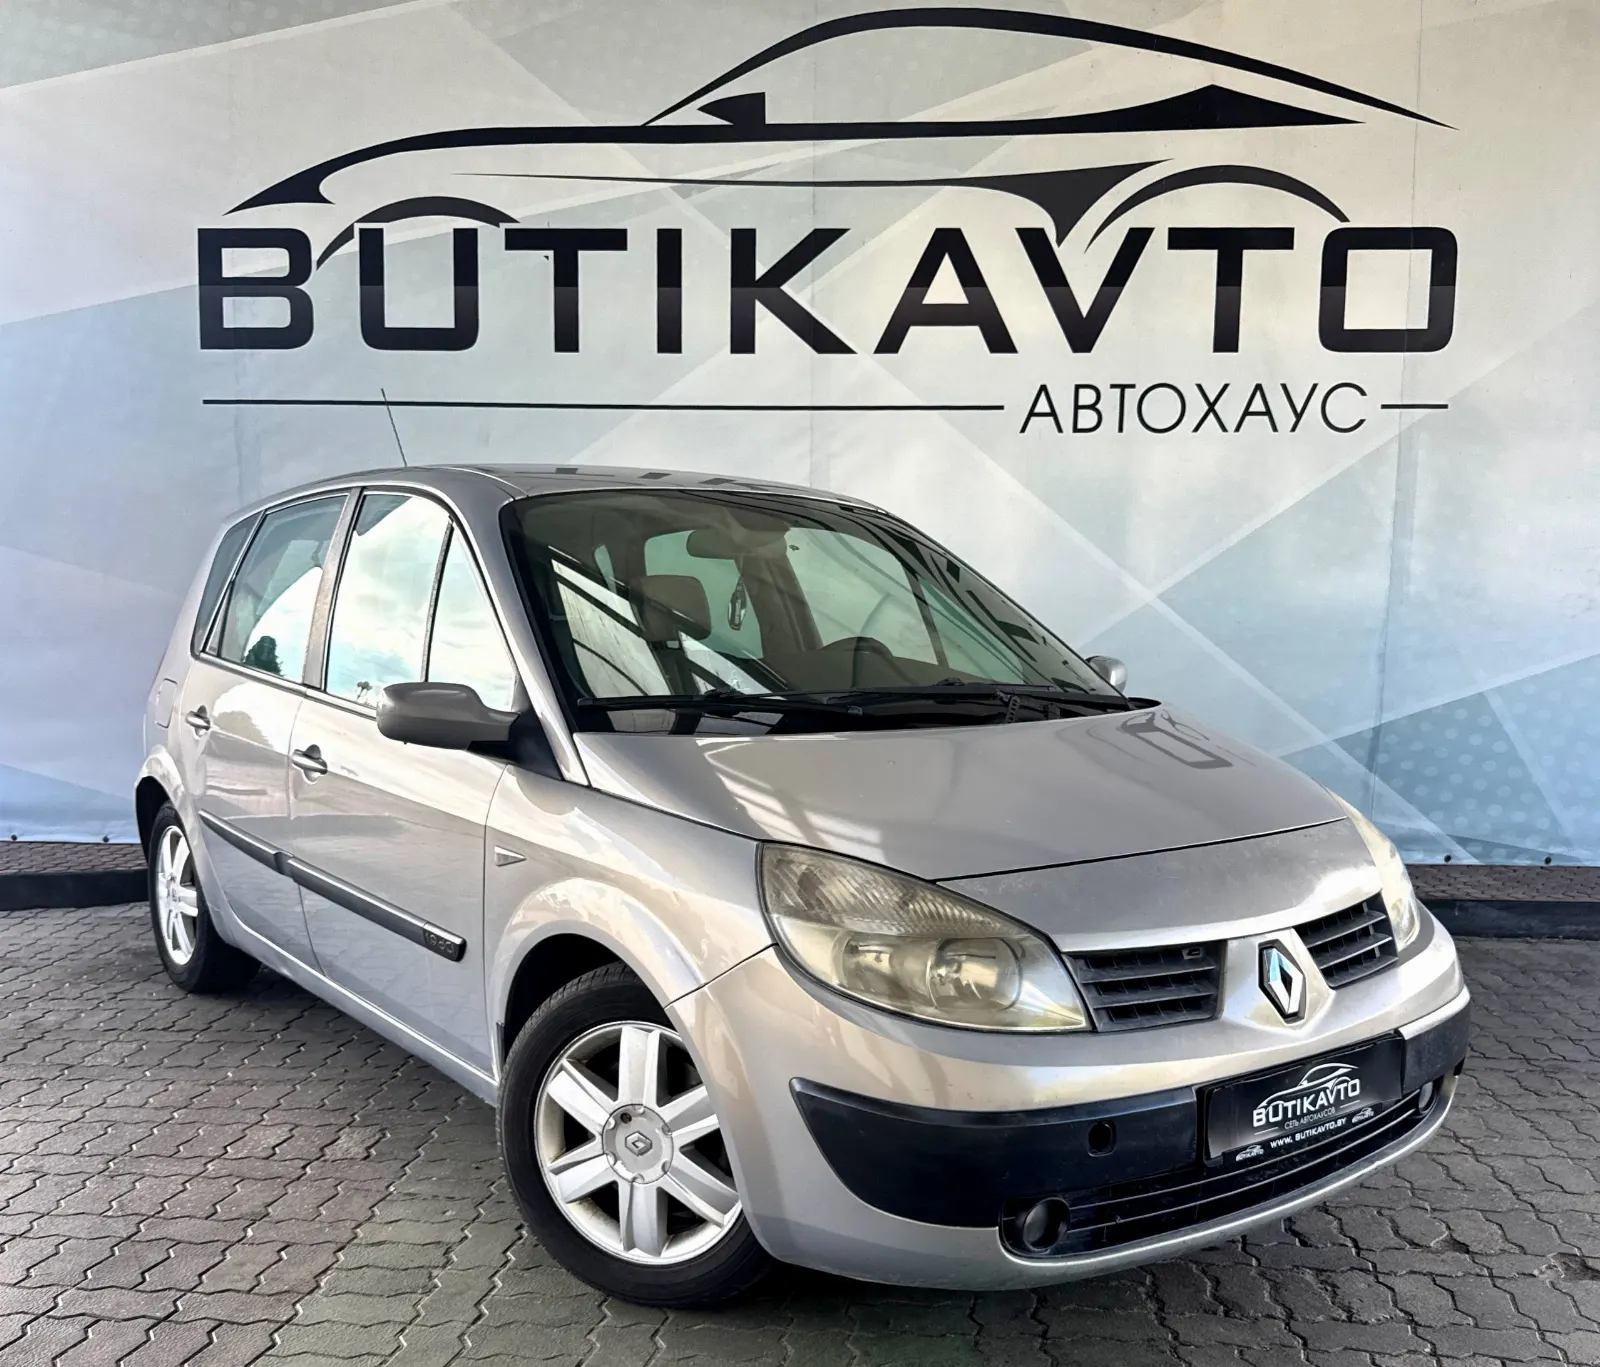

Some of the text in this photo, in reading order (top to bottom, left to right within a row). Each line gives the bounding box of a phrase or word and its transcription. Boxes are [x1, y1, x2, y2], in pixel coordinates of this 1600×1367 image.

[198, 228, 1457, 355] BUTIKAVTO
[1019, 382, 1368, 434] АВТОХАУС
[1253, 1078, 1360, 1127] BUTIKAVTO
